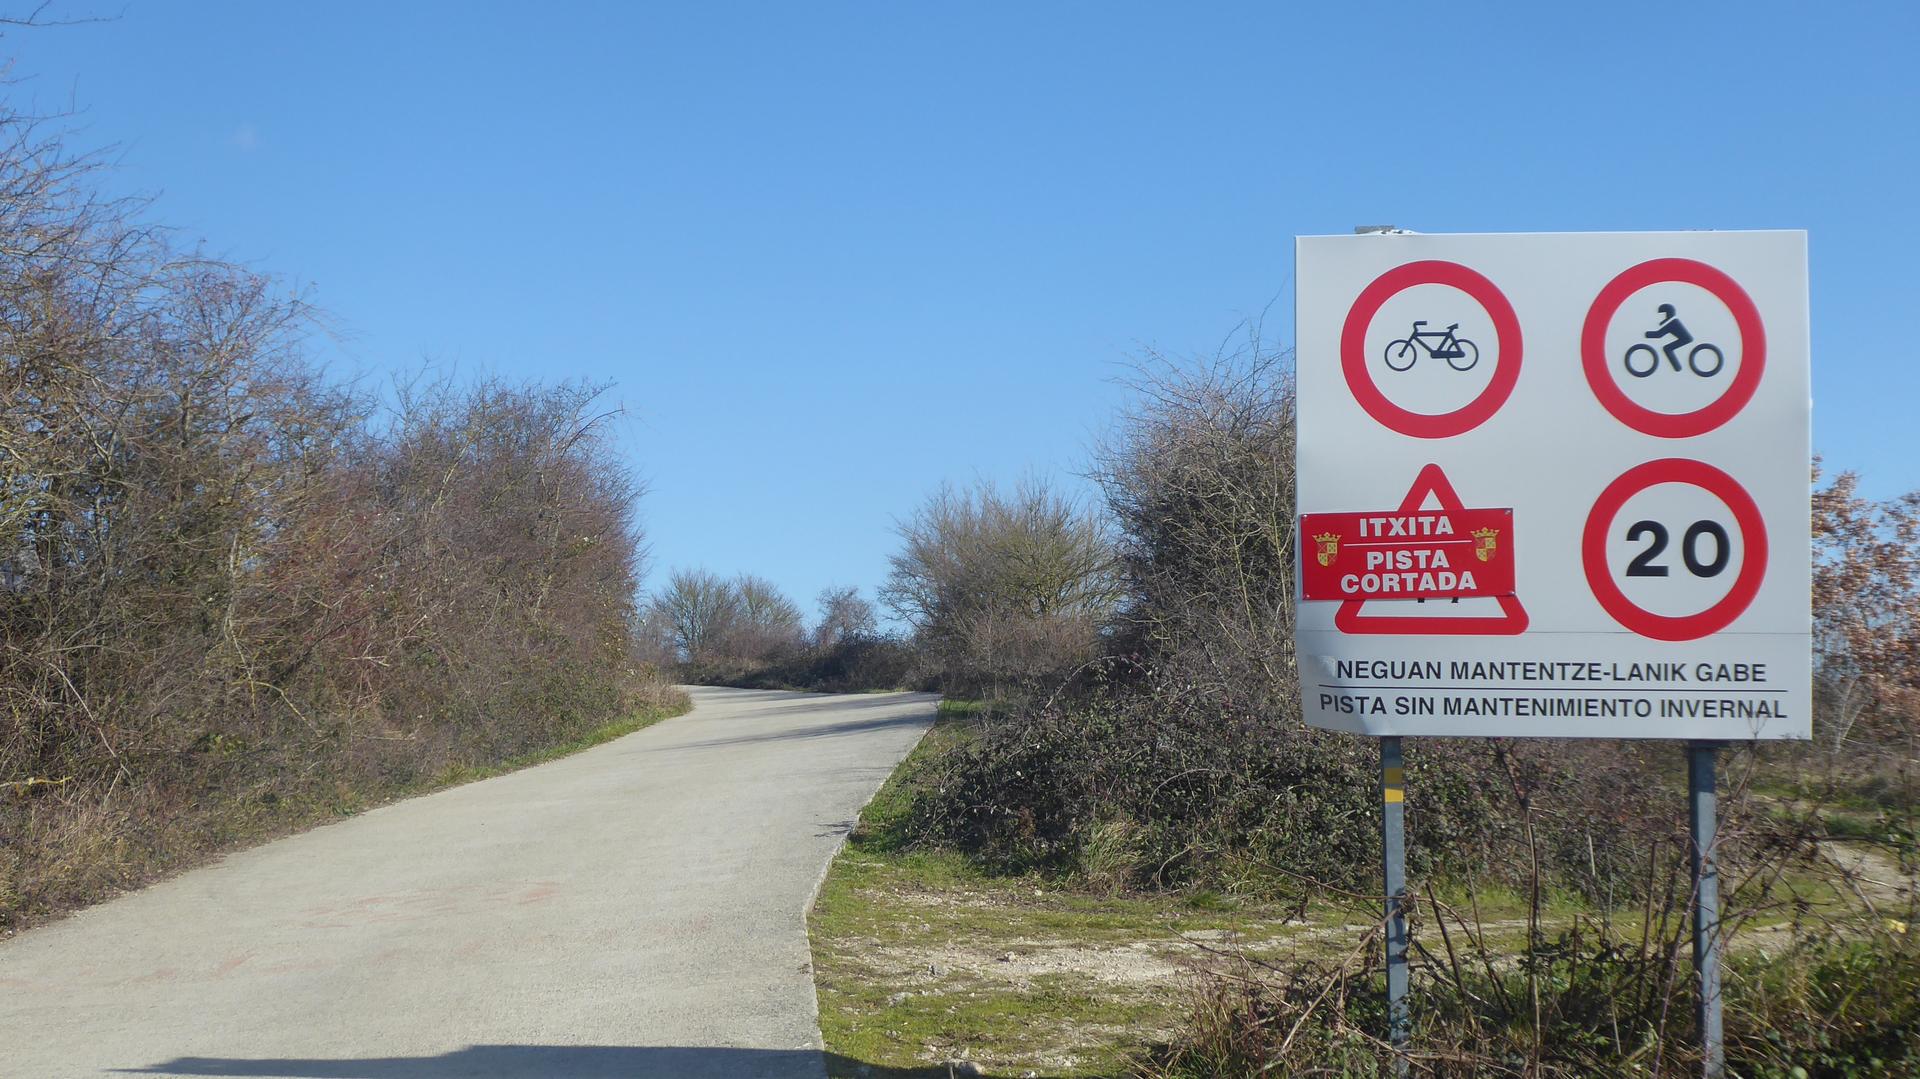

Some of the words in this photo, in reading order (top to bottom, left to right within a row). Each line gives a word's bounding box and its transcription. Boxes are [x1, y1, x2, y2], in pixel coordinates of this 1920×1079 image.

[1359, 516, 1454, 537] ITXITA
[1366, 549, 1450, 570] PISTA
[1625, 519, 1731, 578] 20
[1340, 571, 1478, 593] CORTADA
[1337, 660, 1442, 680] NEGUAN
[1450, 661, 1688, 682] MANTENTZE-LANIK
[1695, 663, 1767, 682] GABE
[1319, 693, 1387, 715] PISTA
[1394, 696, 1435, 715] SIN
[1443, 697, 1652, 717] MANTENIMIENTO
[1660, 699, 1788, 719] INVERNAL
